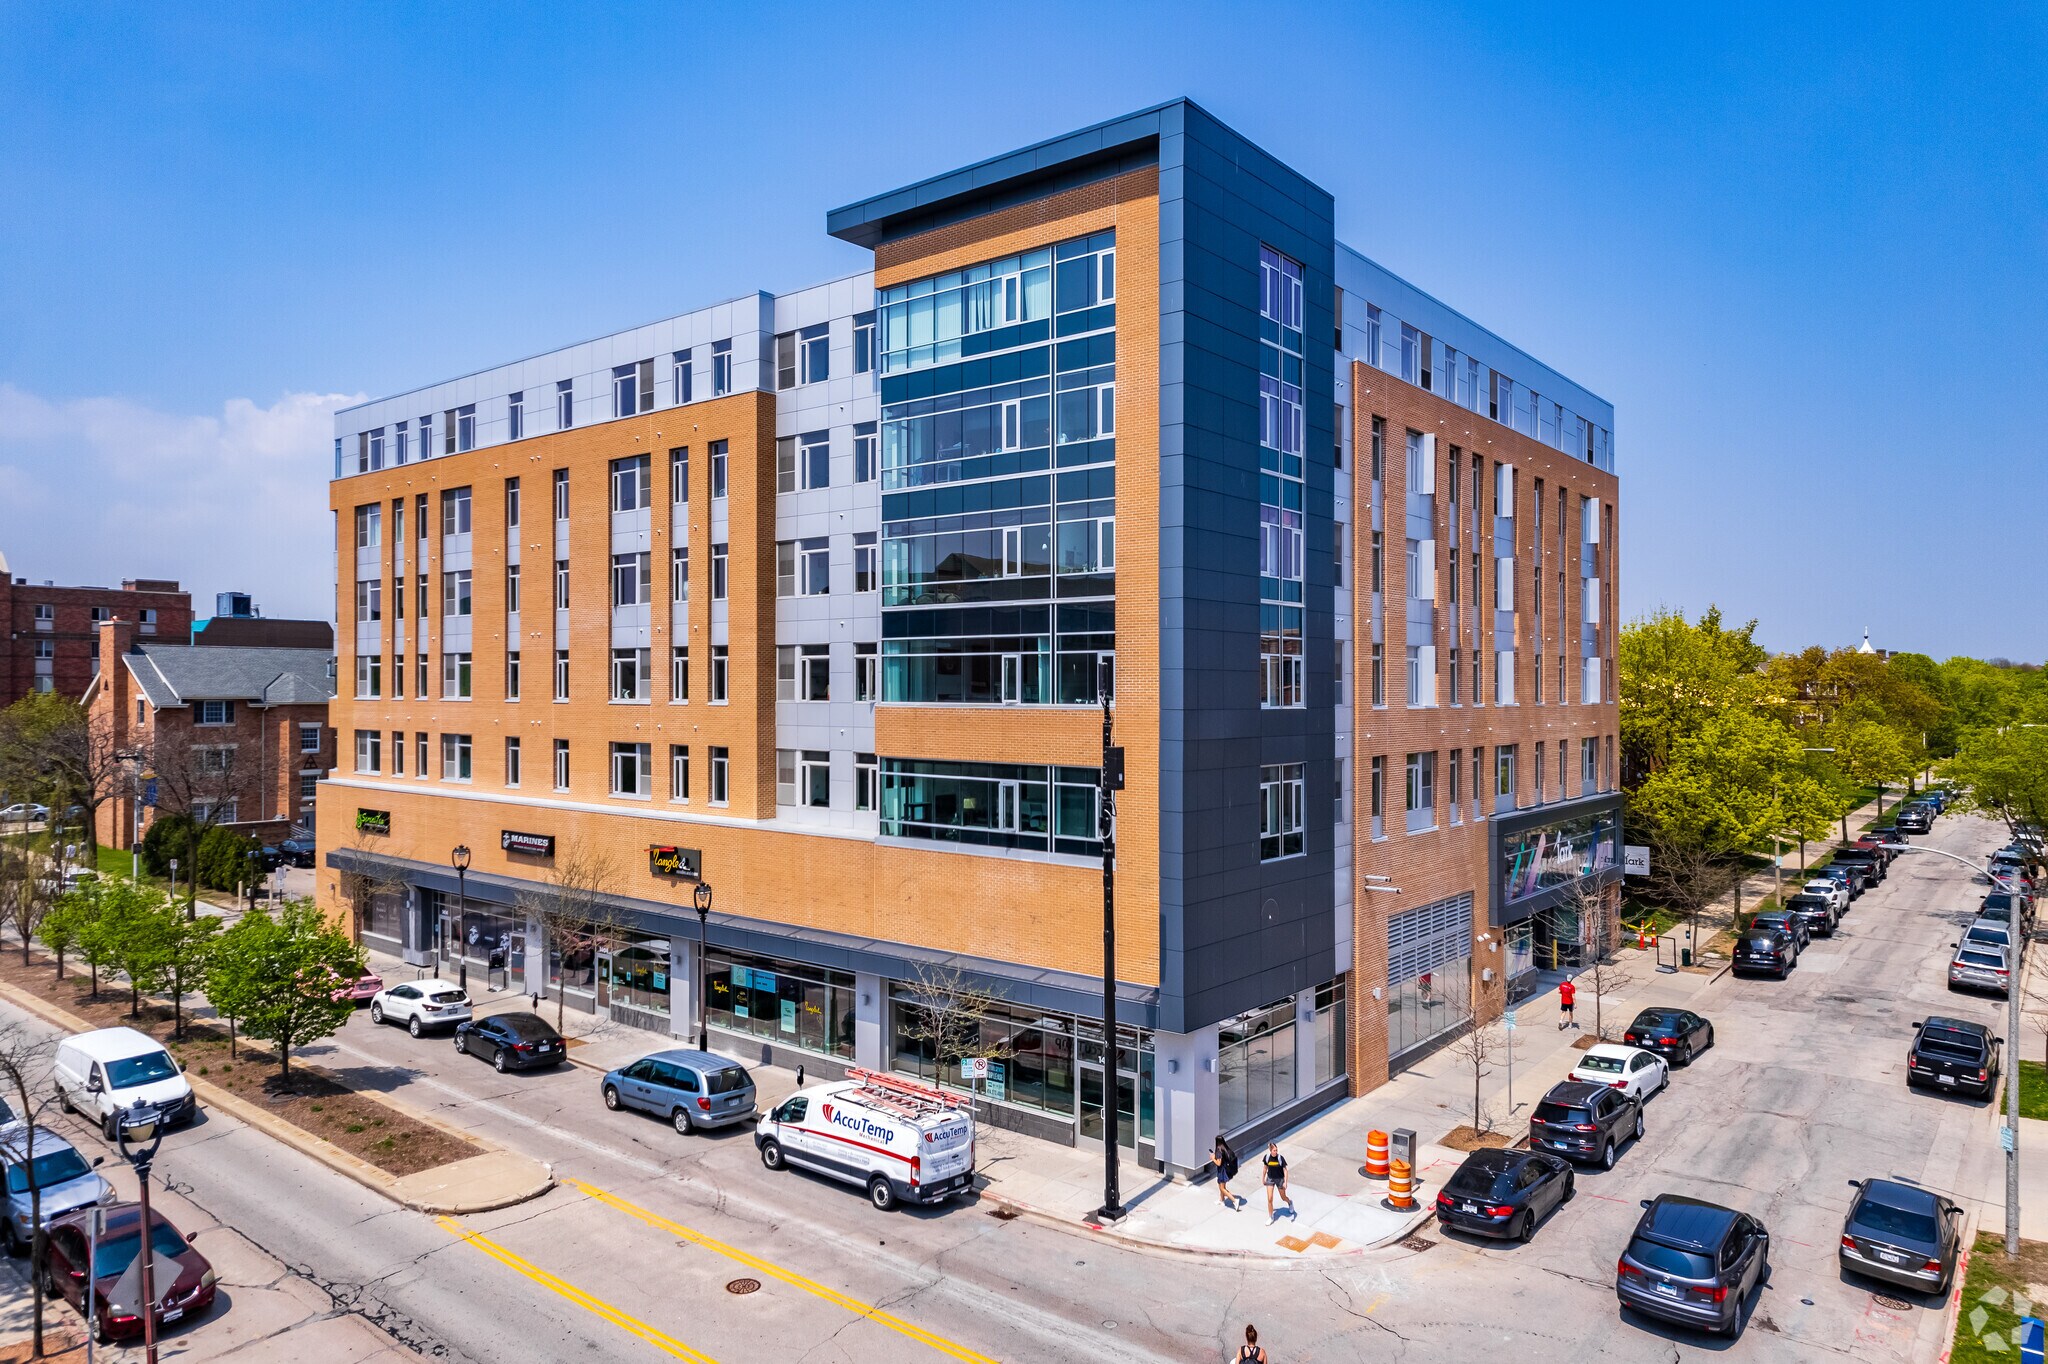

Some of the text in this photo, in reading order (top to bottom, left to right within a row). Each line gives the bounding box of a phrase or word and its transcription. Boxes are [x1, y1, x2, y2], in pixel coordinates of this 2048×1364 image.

[511, 834, 549, 847] MARINES
[1557, 840, 1573, 864] lark
[1625, 856, 1645, 866] lark
[833, 1110, 894, 1145] AccuTemp
[934, 1125, 968, 1141] AccuTemp
